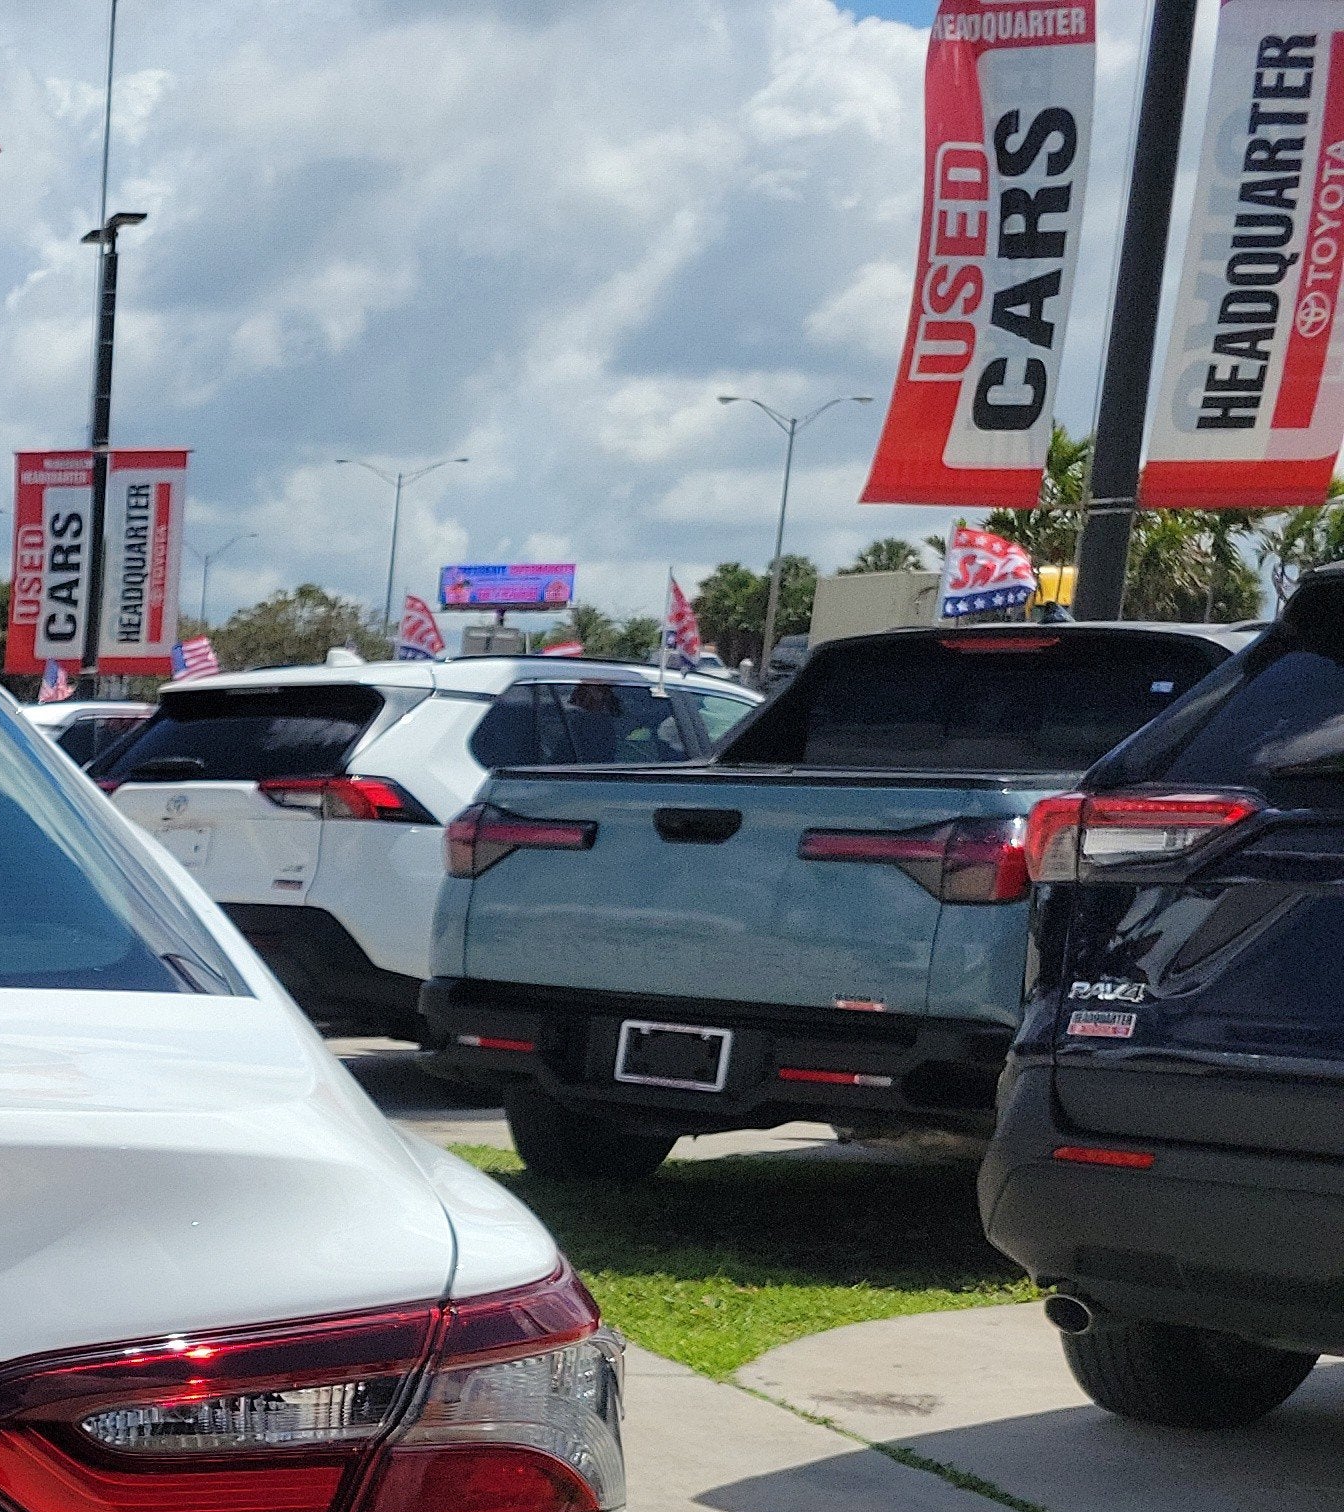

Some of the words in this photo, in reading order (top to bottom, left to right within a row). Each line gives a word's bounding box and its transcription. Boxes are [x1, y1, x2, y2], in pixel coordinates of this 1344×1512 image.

[908, 142, 990, 381] USED
[972, 106, 1078, 430] CARS
[1196, 34, 1318, 429] HEADQUARTER
[13, 524, 44, 625] USED
[44, 511, 84, 644] CARS
[118, 483, 152, 644] HEADQUARTER
[1067, 981, 1146, 1003] RAV4
